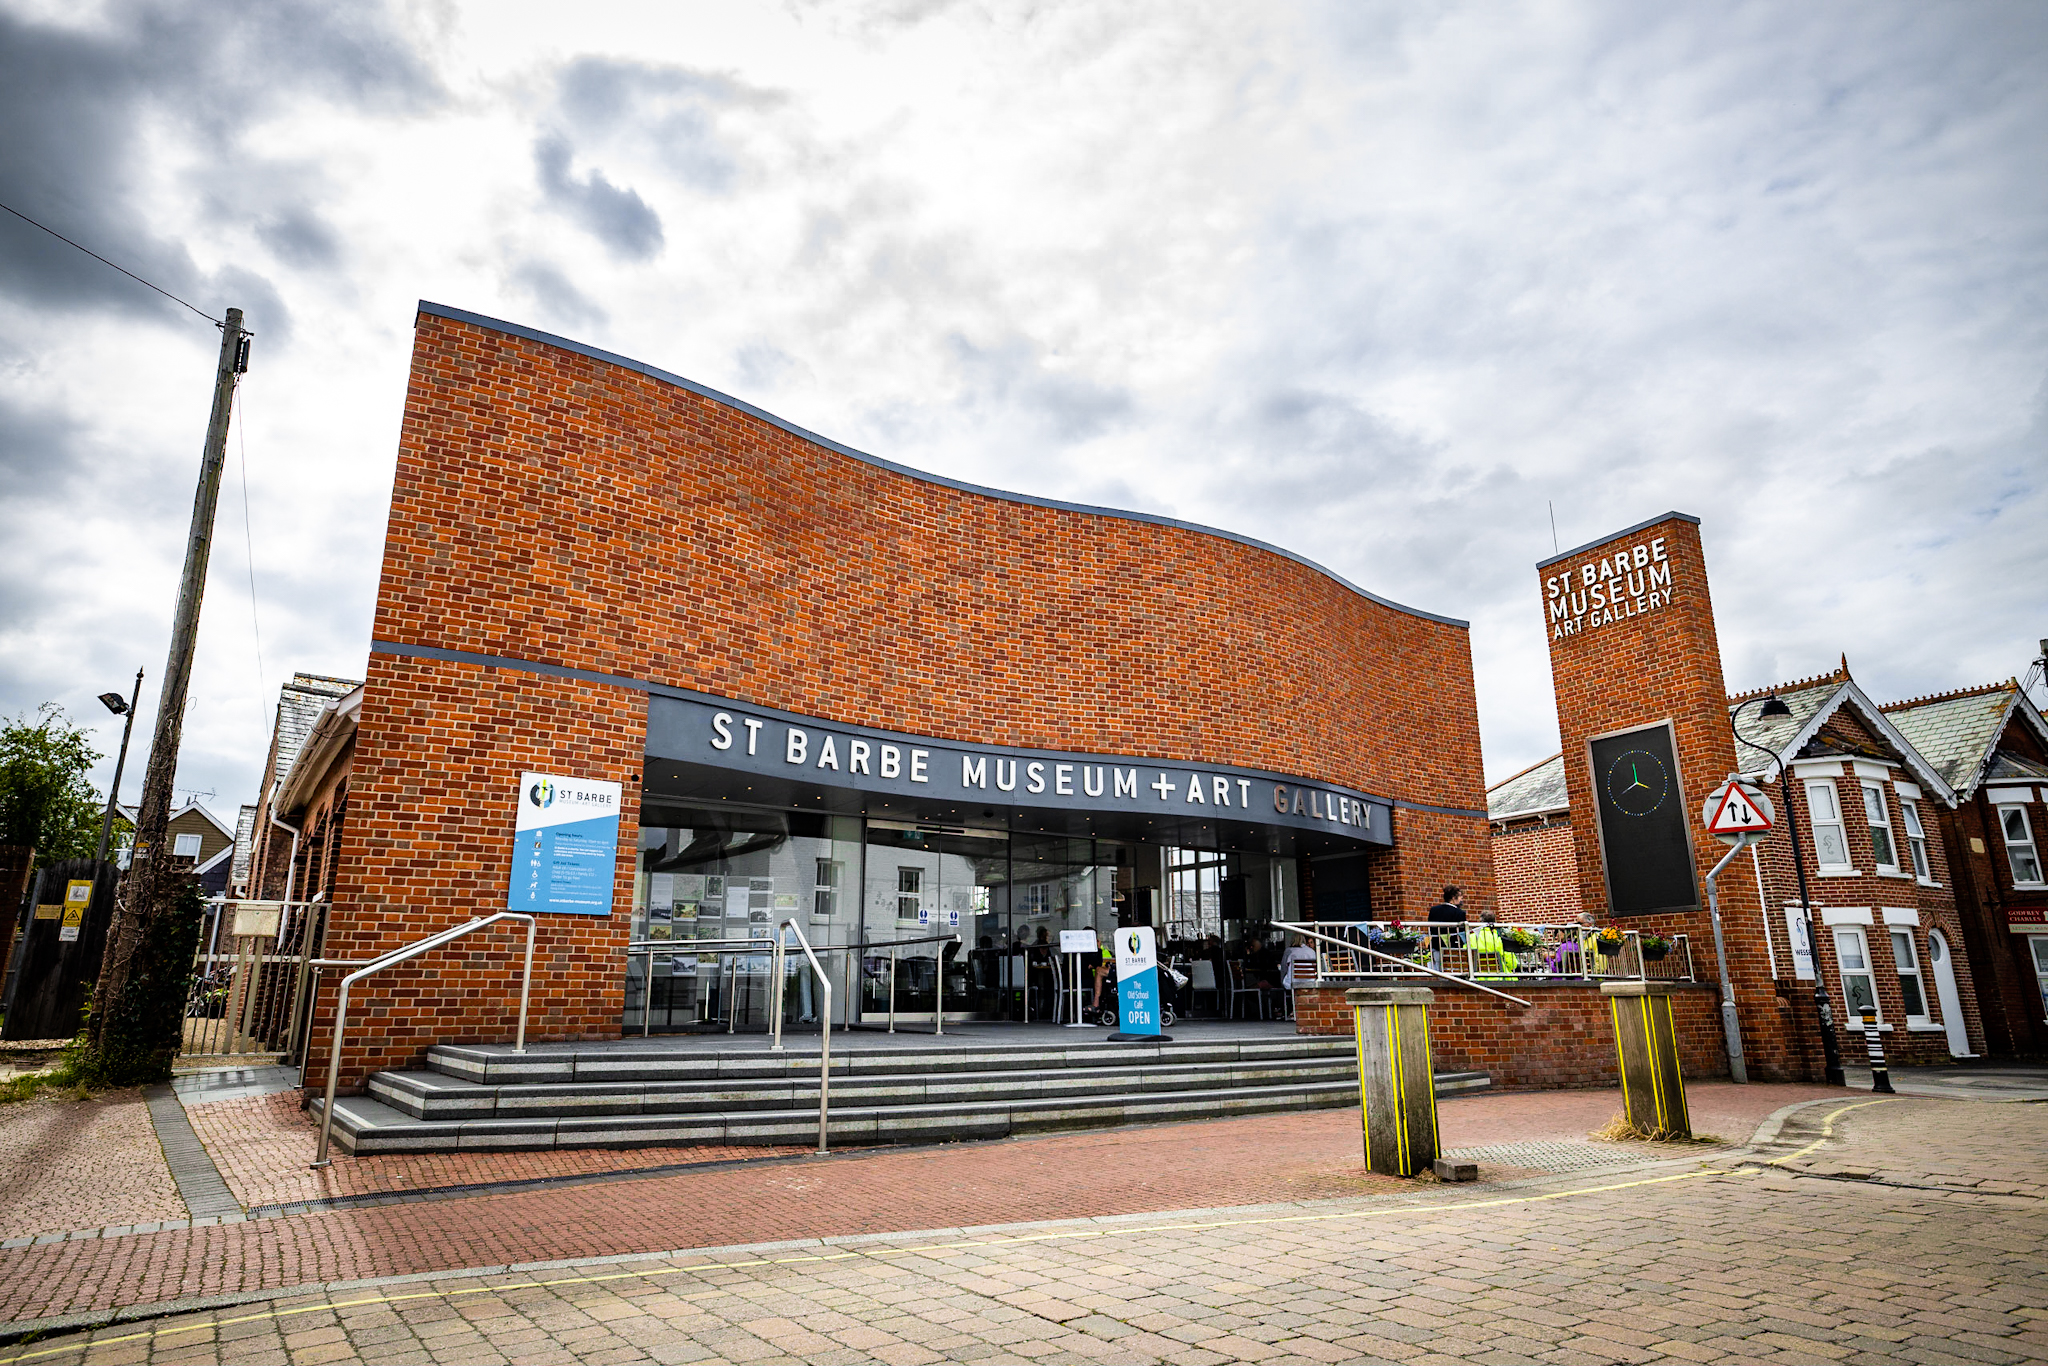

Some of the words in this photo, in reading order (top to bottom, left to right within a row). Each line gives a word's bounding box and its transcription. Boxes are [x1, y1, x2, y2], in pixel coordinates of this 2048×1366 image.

[1547, 571, 1572, 599] ST
[1582, 537, 1668, 587] BARBE
[1550, 560, 1672, 623] MUSEUM
[1554, 616, 1583, 640] ART
[1590, 587, 1672, 628] GALLERY
[711, 712, 763, 755] ST
[786, 727, 929, 783] BARBE
[962, 755, 1137, 799] MUSEUM
[1186, 773, 1251, 808] ART
[1274, 784, 1372, 829] GALLERY
[560, 789, 572, 799] ST
[577, 791, 612, 804] BARBE
[1127, 991, 1136, 999] Old
[1136, 991, 1149, 999] School
[1133, 981, 1141, 989] The
[1128, 1011, 1150, 1024] OPEN
